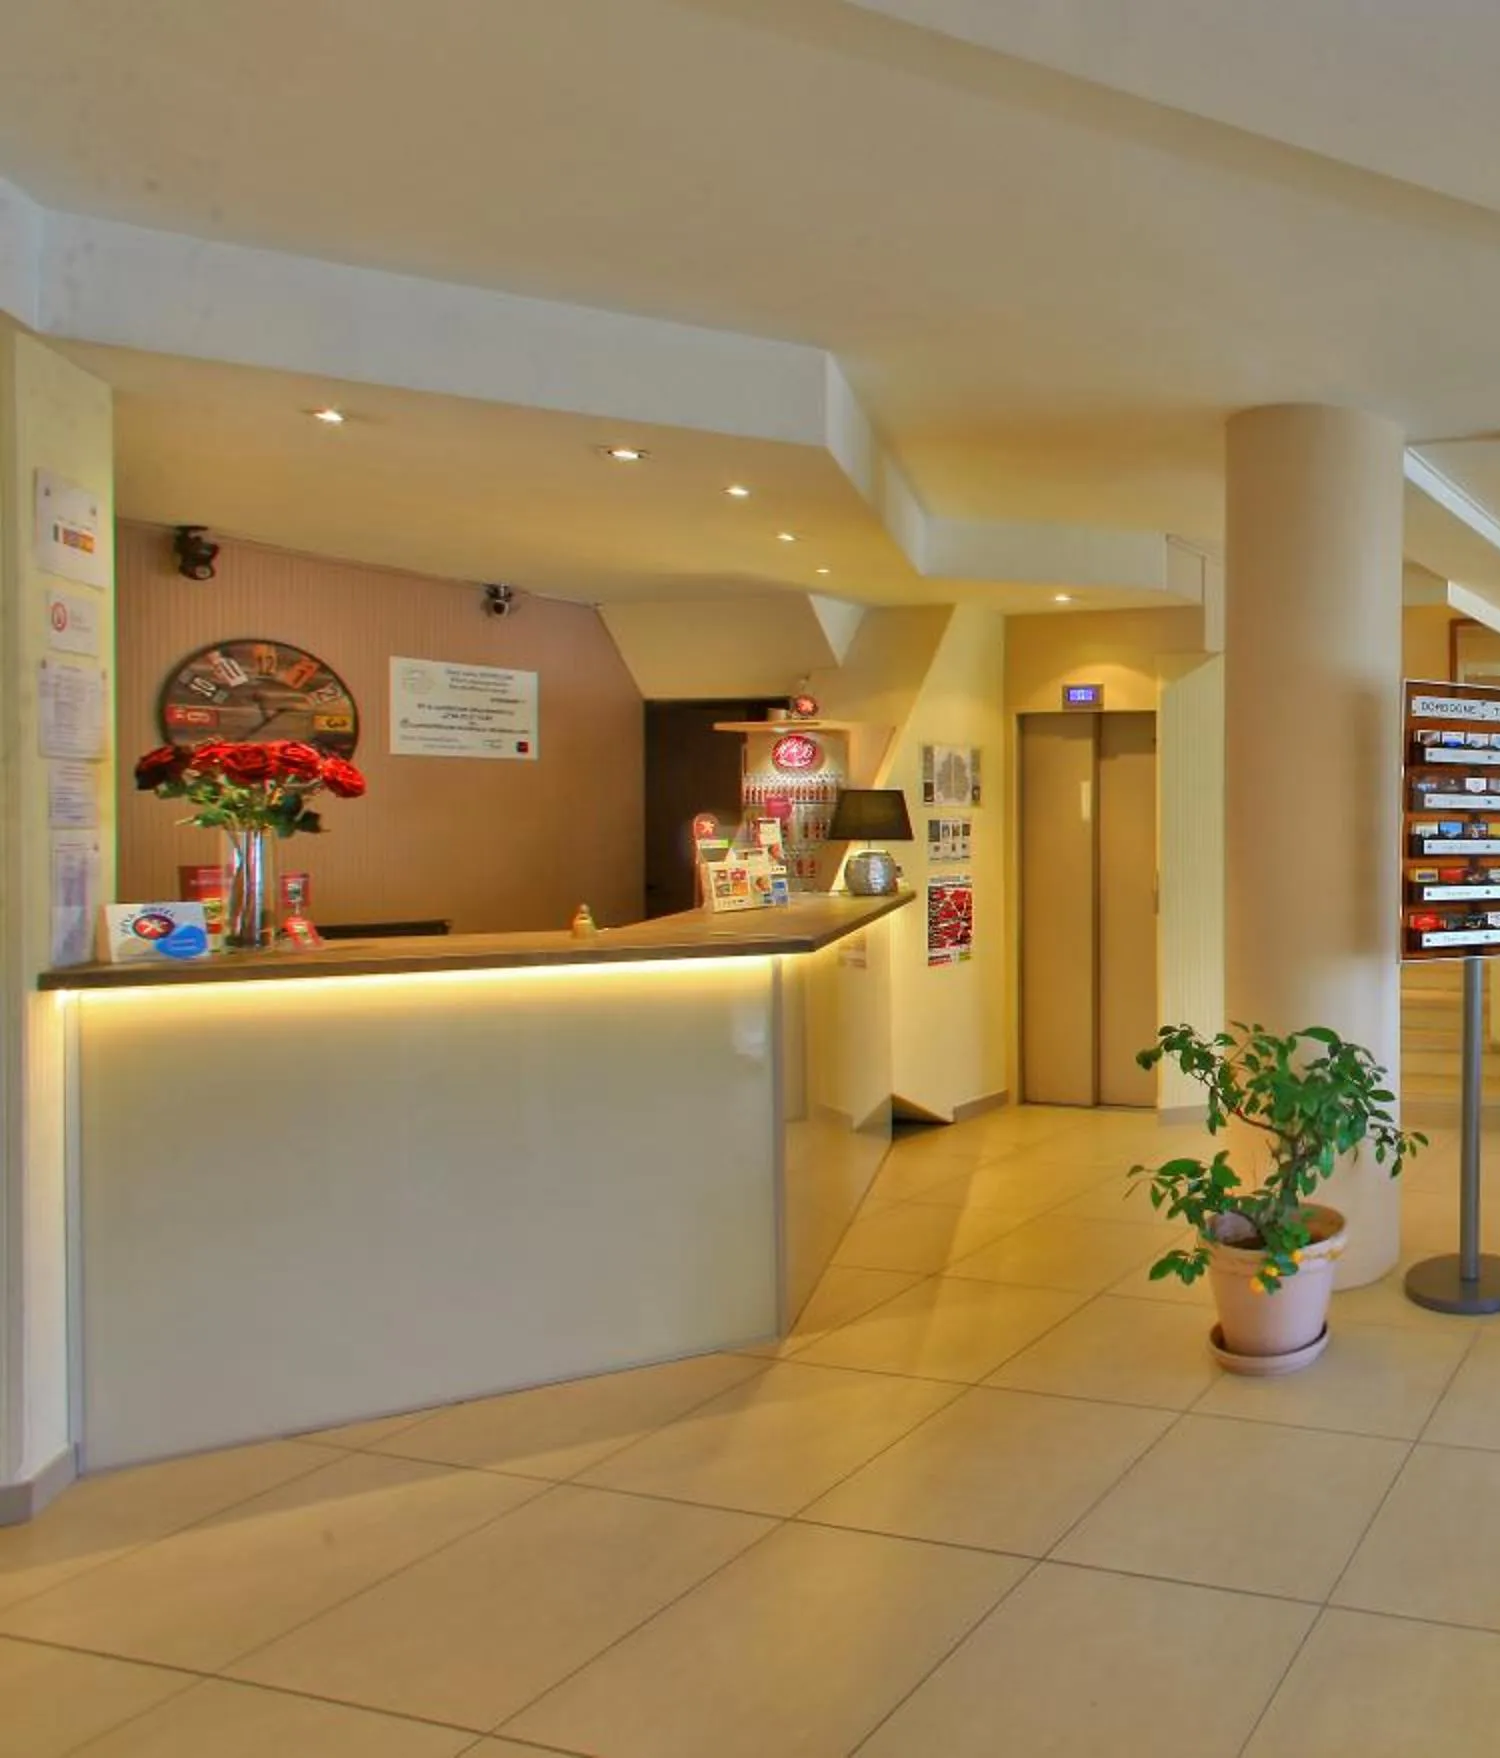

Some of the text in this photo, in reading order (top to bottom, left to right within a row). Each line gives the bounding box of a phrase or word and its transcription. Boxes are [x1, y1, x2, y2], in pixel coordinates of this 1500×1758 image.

[256, 655, 276, 675] 12
[188, 676, 217, 698] 10
[325, 718, 348, 729] 3
